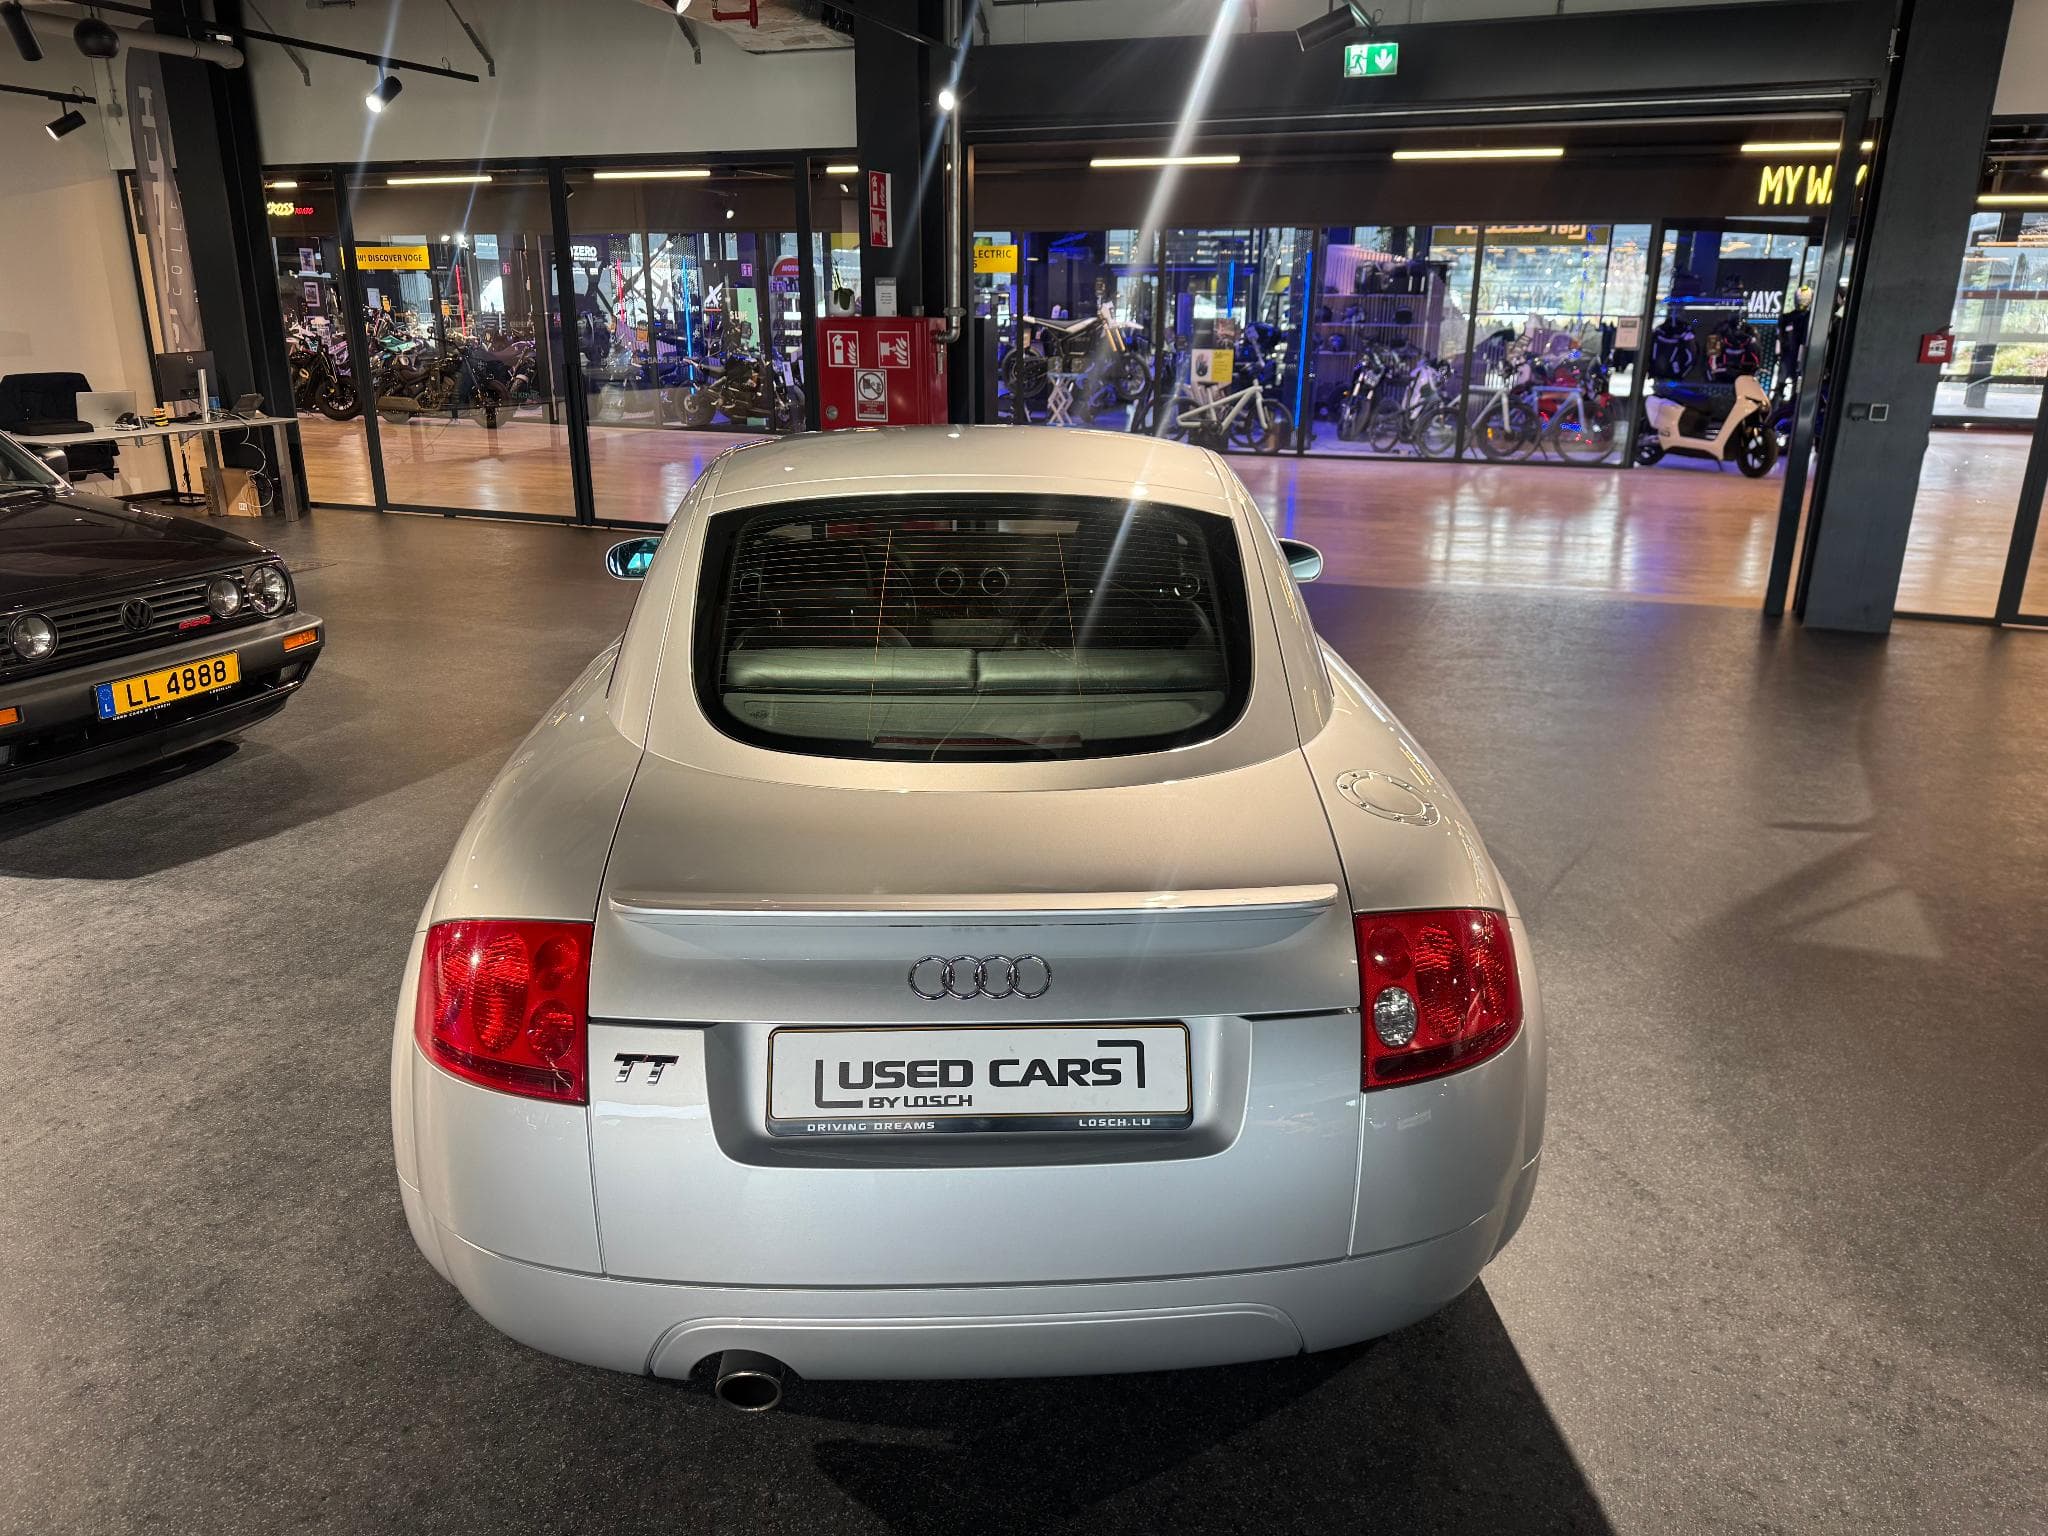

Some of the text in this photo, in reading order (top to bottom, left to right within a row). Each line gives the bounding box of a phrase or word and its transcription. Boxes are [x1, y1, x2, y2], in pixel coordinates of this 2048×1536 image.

[368, 254, 402, 263] DISCOVER
[403, 254, 423, 262] VOGE
[126, 660, 227, 707] LL 4888
[104, 703, 111, 713] L
[614, 1053, 680, 1084] TT
[838, 1057, 1122, 1090] USED CARS
[868, 1094, 973, 1109] BY LOSCH
[807, 1117, 1152, 1131] DRIVING DREAMS LOSCH.LU
